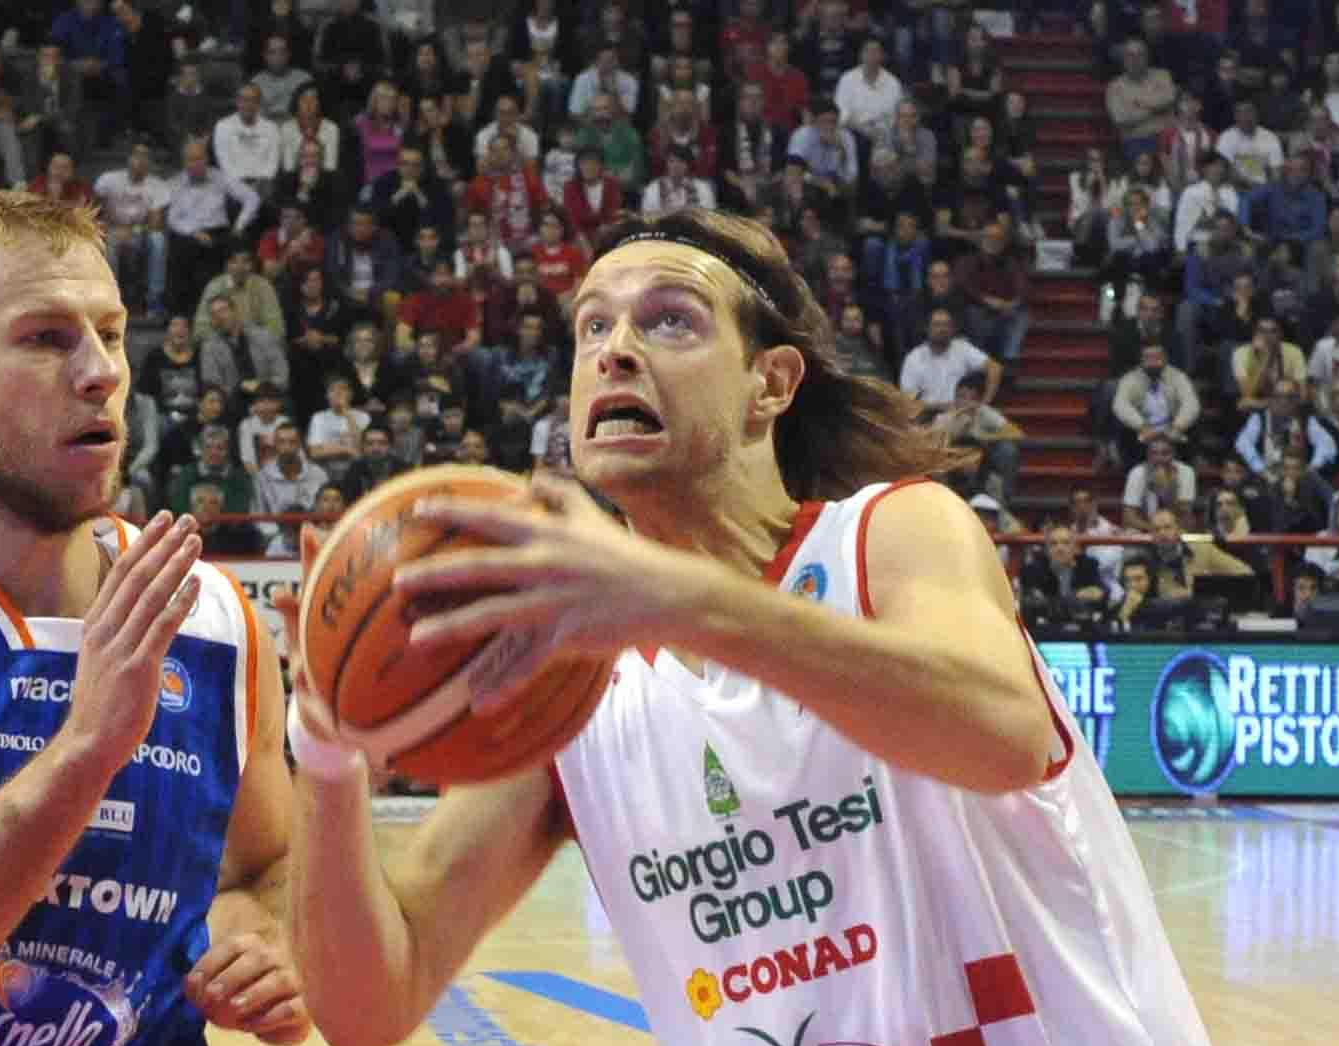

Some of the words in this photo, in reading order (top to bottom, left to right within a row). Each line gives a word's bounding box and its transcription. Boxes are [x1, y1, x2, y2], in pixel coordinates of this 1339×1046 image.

[628, 824, 775, 904] Giorgio
[773, 776, 884, 852] Tesi
[688, 869, 834, 944] Group
[16, 940, 118, 978] MINERALE
[721, 923, 879, 1003] CONAD
